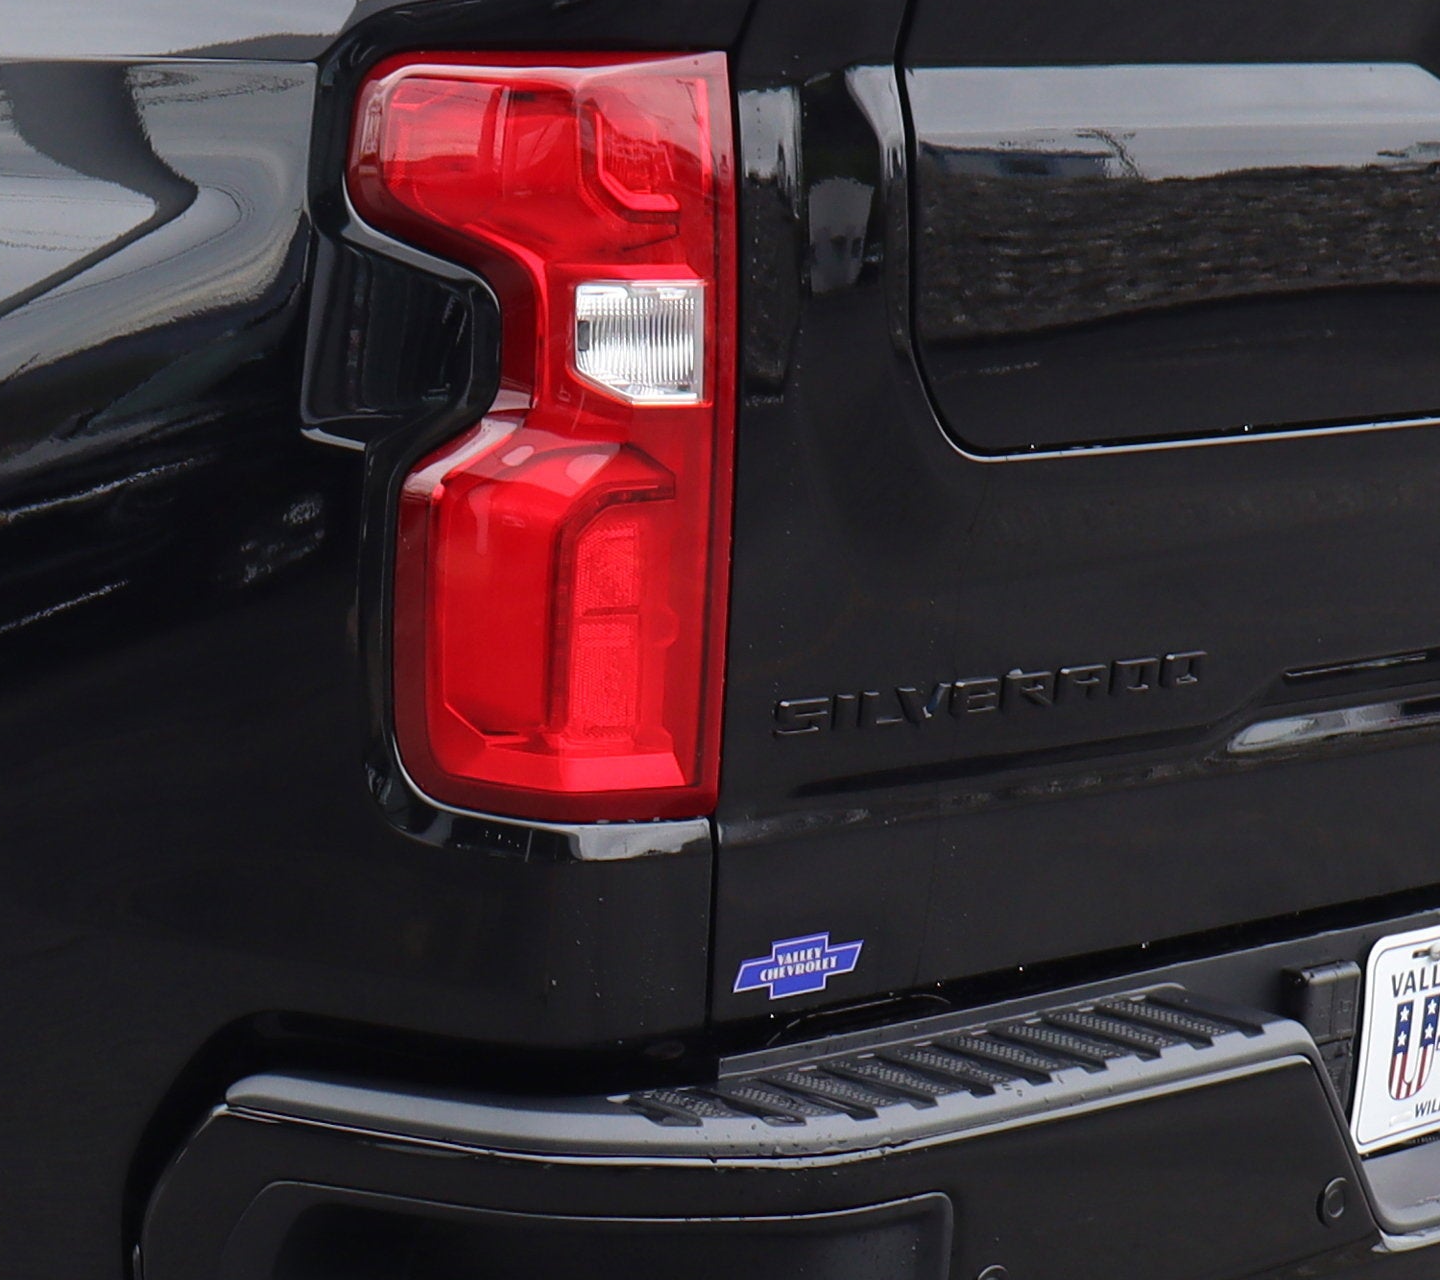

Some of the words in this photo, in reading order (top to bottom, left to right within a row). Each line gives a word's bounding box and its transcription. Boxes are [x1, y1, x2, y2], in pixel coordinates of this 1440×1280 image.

[774, 650, 1208, 738] SILVERADO
[759, 956, 838, 982] CHEVROLET
[776, 946, 823, 966] VALLEY
